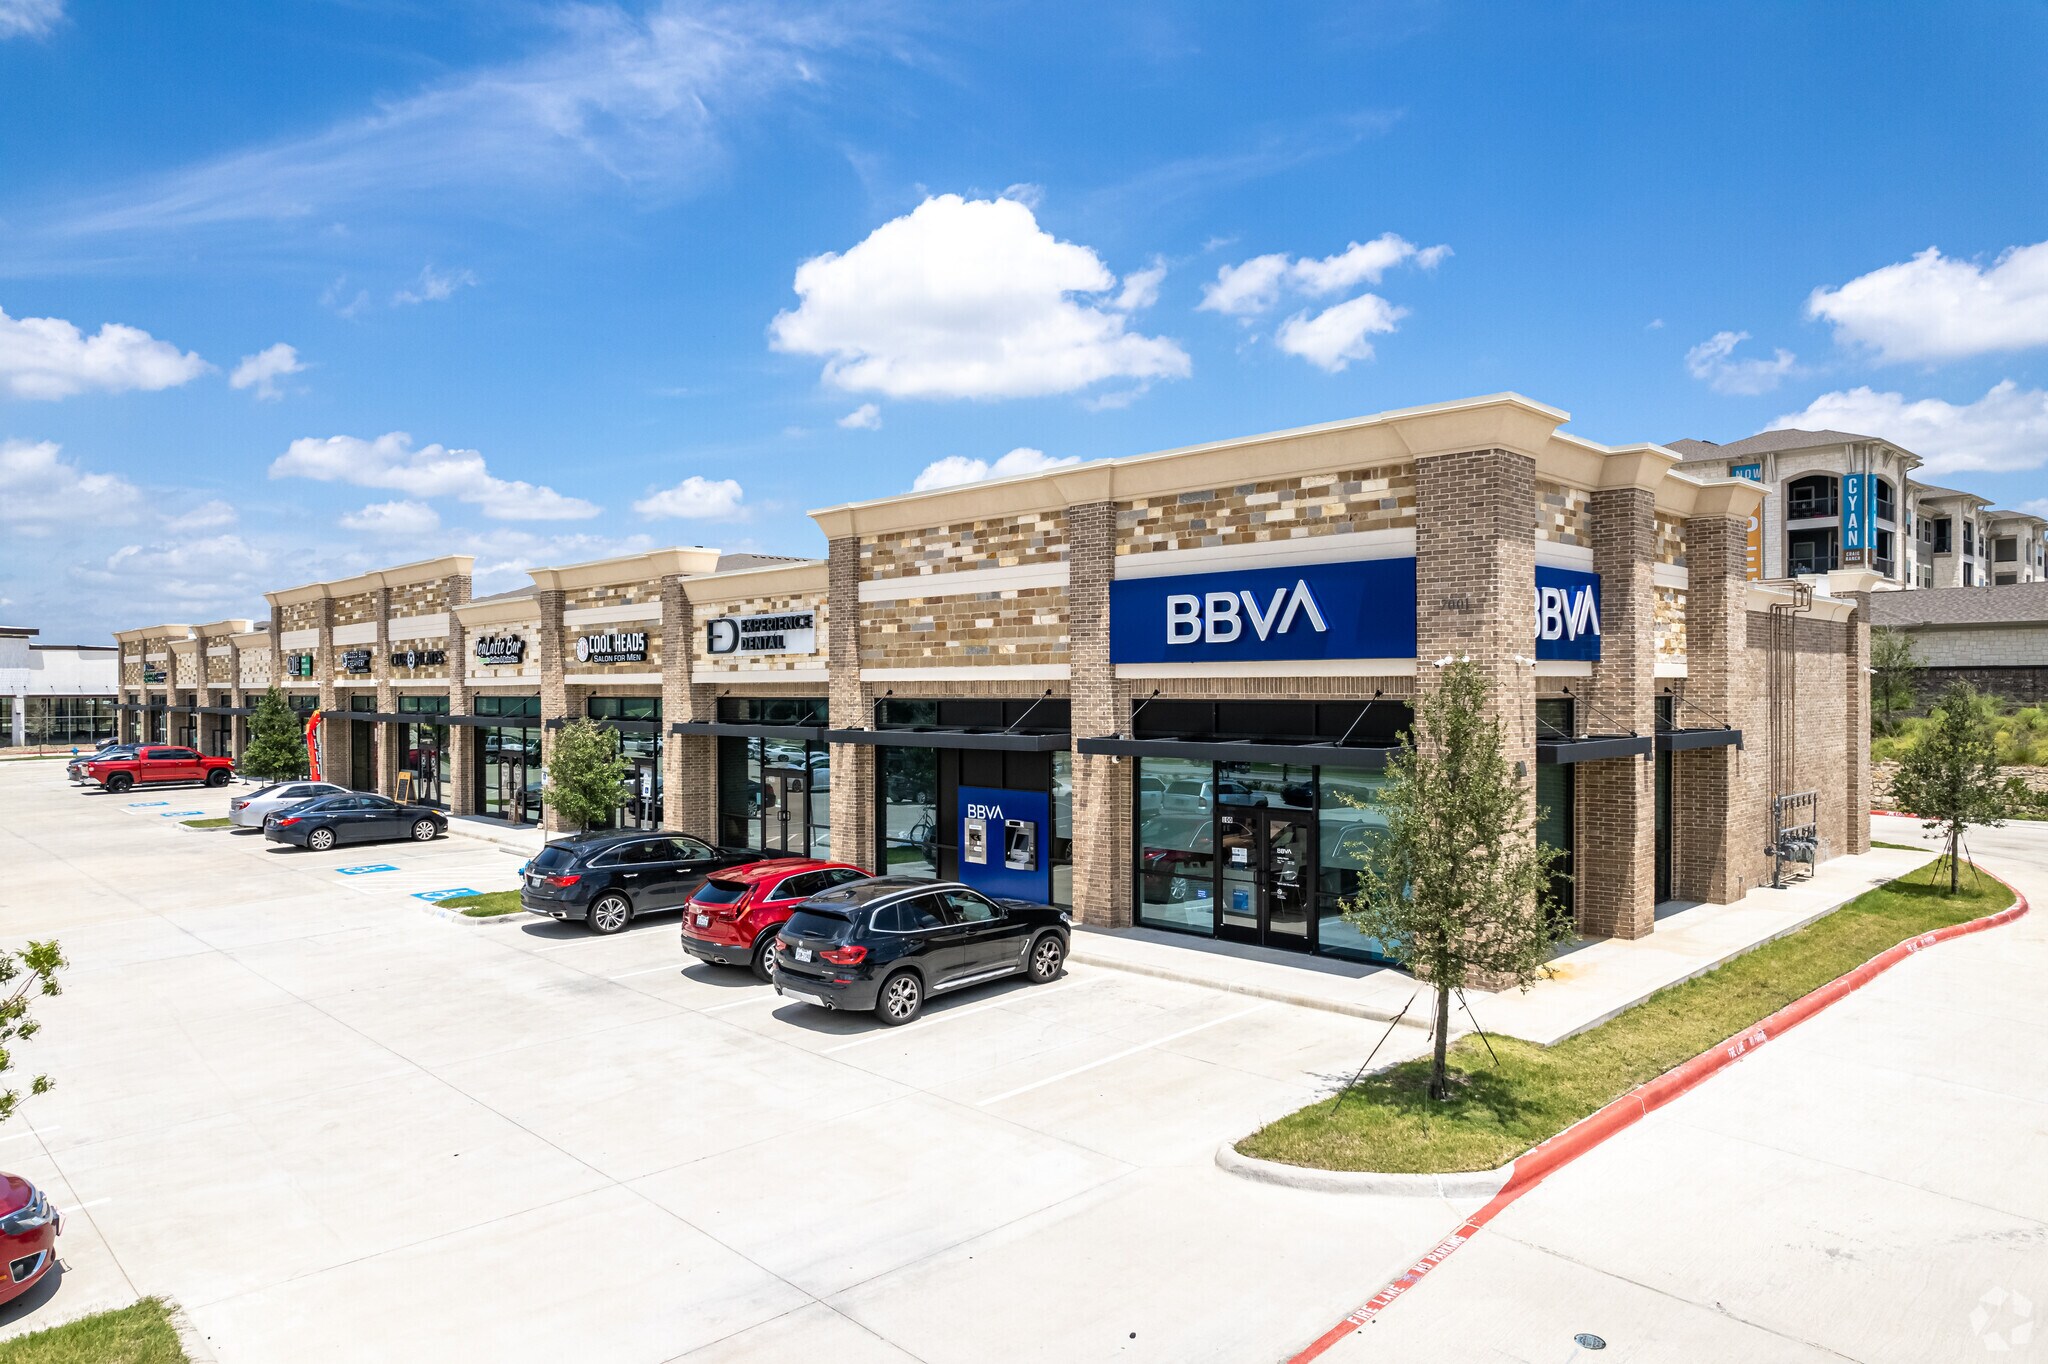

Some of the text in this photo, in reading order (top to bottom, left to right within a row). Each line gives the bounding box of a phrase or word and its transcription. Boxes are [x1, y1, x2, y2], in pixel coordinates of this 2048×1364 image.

[1848, 478, 1857, 546] CYAN
[1167, 579, 1327, 645] BBVA
[1535, 585, 1600, 641] BVA
[741, 615, 813, 632] EXPERIENCE
[505, 635, 521, 655] Bar
[589, 633, 645, 653] COOL HEADS
[741, 634, 785, 650] DENTAL
[614, 654, 626, 662] FOR
[627, 653, 641, 661] MEN
[968, 804, 1004, 820] BBVA
[1346, 1235, 1467, 1325] FIRE LANE NO PARKING
